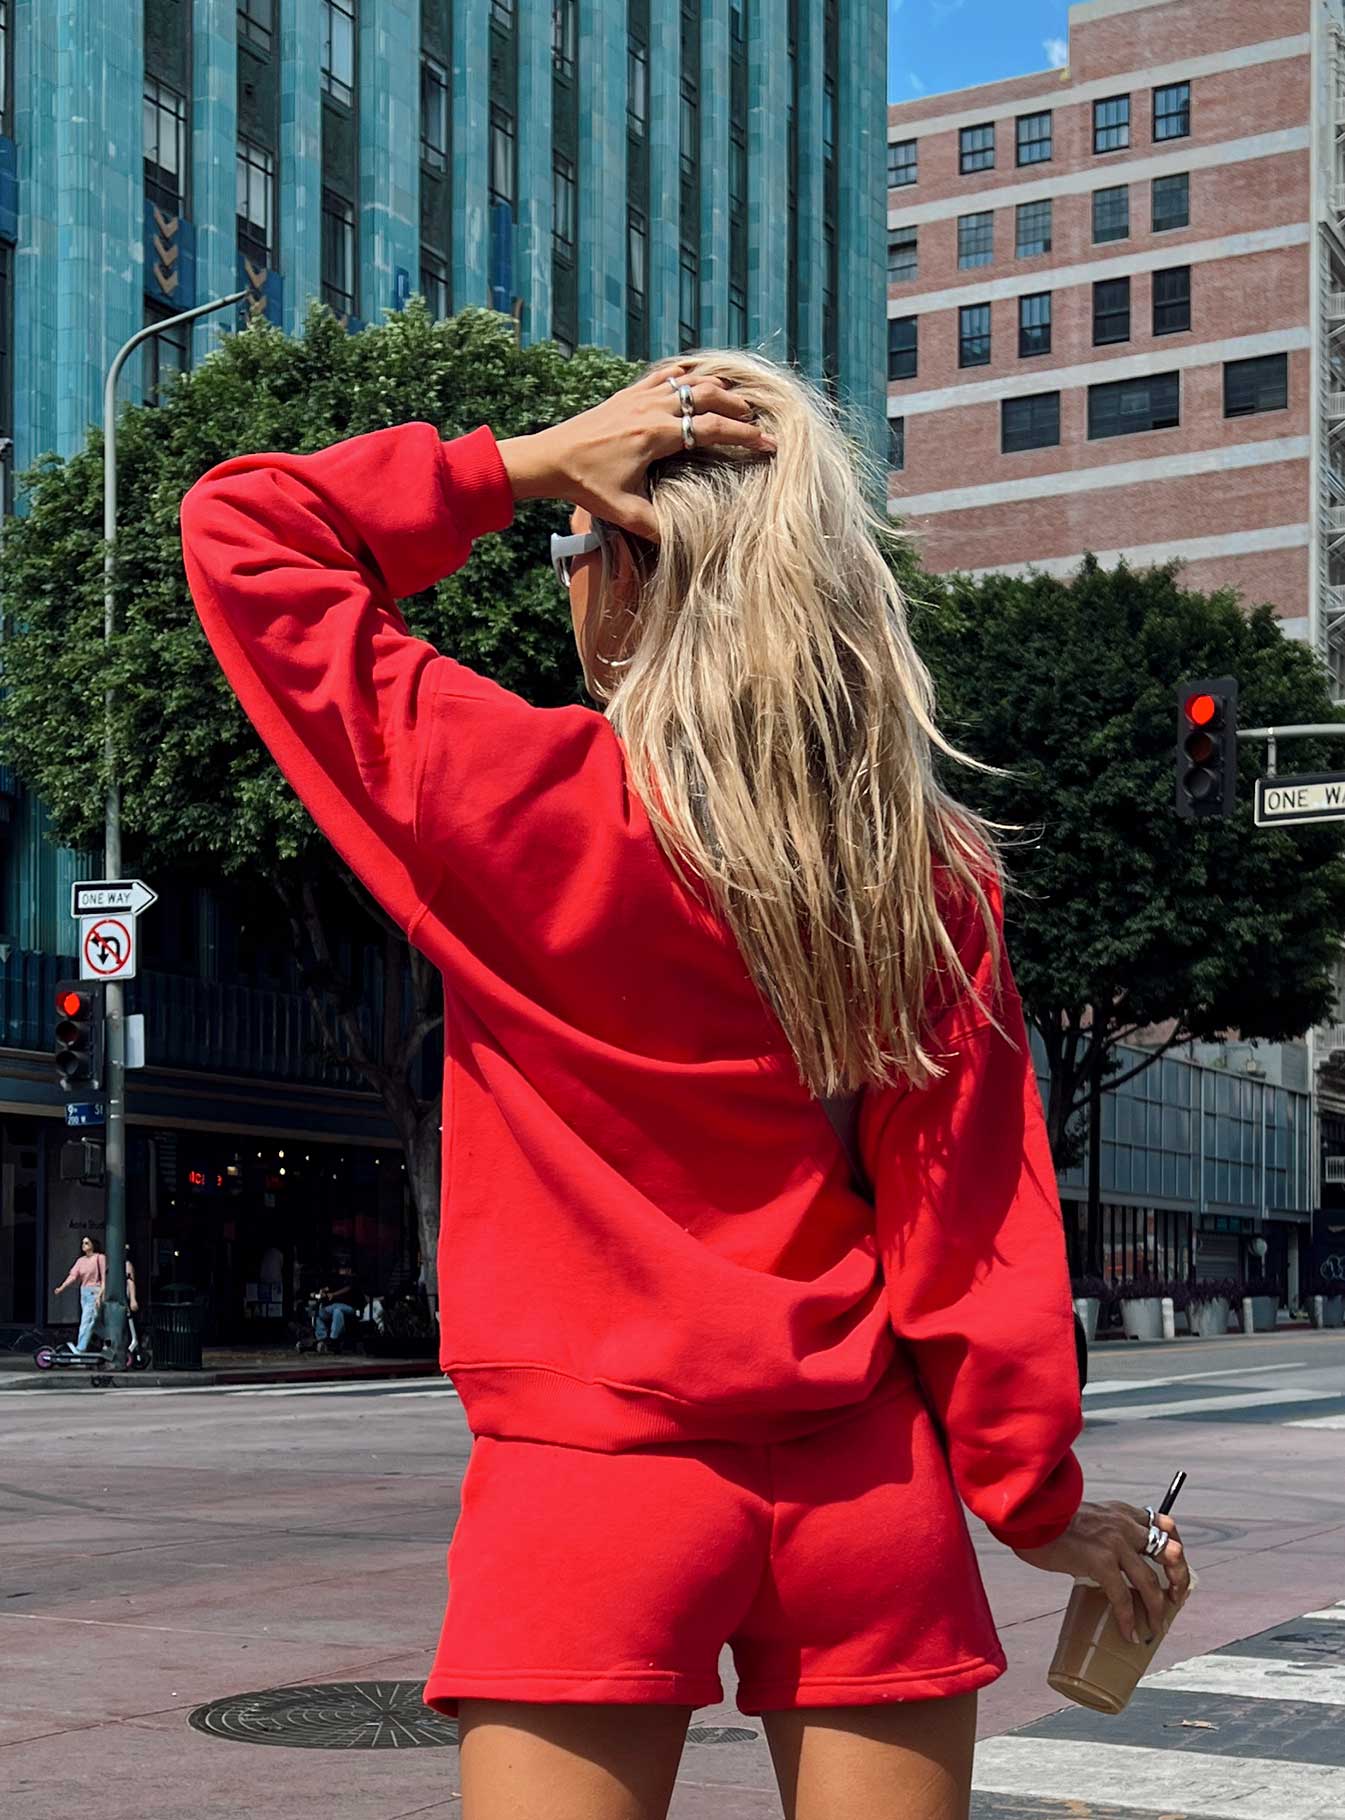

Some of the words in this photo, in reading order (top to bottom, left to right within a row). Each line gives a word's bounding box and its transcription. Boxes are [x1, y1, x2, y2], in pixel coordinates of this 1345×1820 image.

[1268, 789, 1308, 810] ONE
[1325, 786, 1345, 805] W
[82, 893, 104, 905] ONE
[107, 891, 131, 904] WAY
